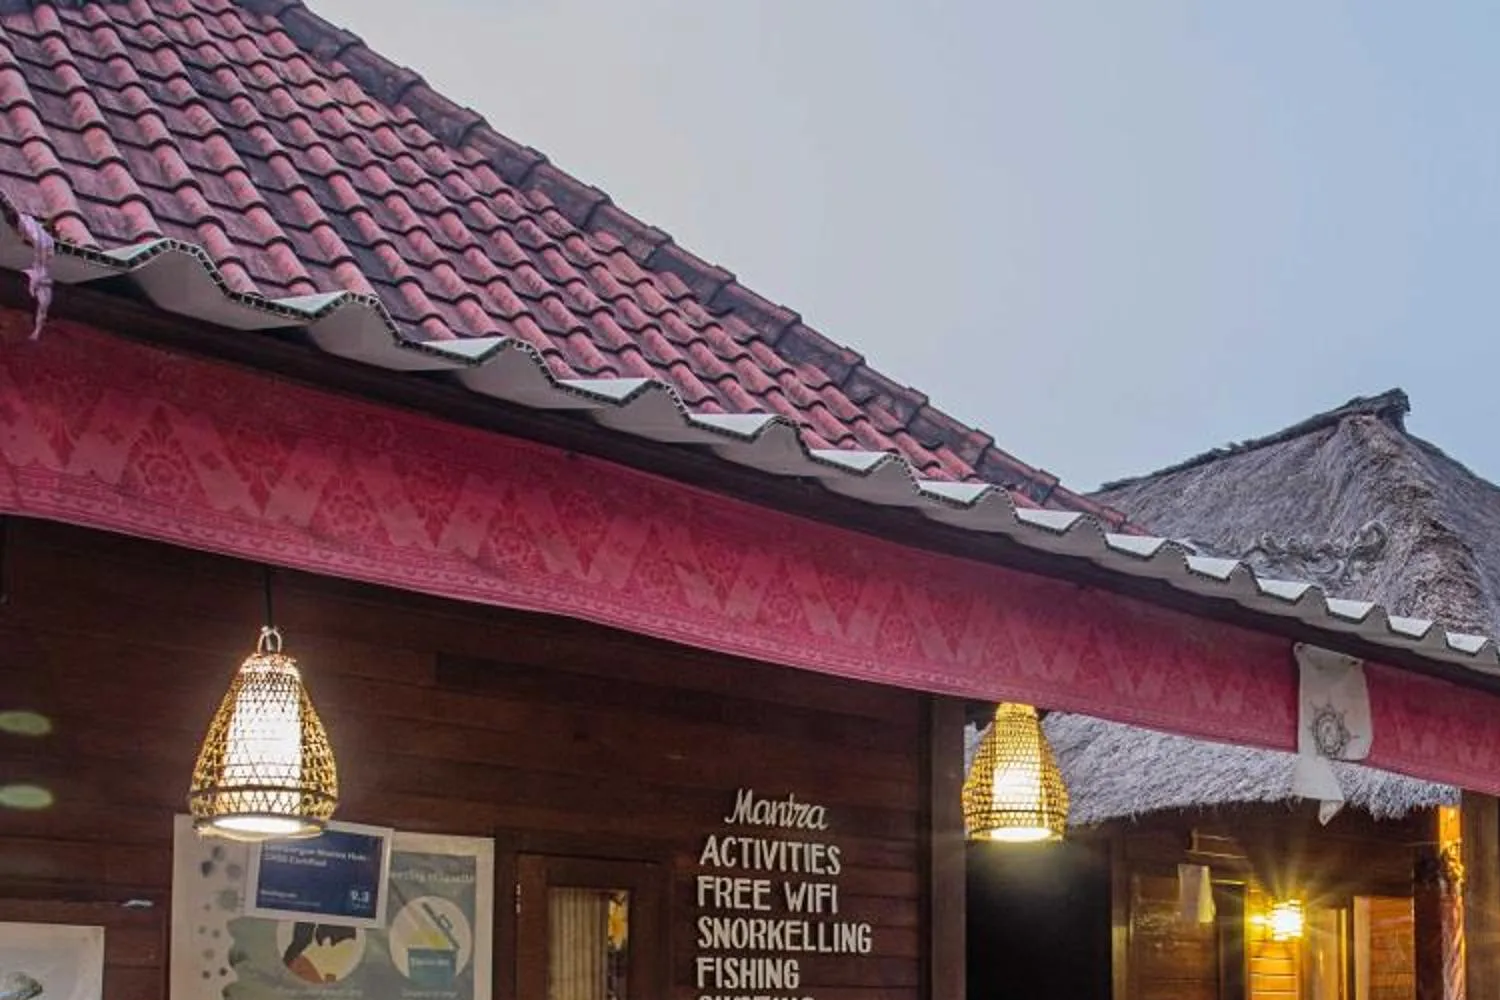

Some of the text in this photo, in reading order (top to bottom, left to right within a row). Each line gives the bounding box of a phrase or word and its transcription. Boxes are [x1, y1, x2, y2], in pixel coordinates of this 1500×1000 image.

[724, 788, 829, 831] Mantra
[699, 834, 841, 875] ACTIVITIES
[697, 875, 838, 914] FREE WIFI
[697, 916, 872, 953] SNORKELLING
[696, 957, 799, 989] FISHING
